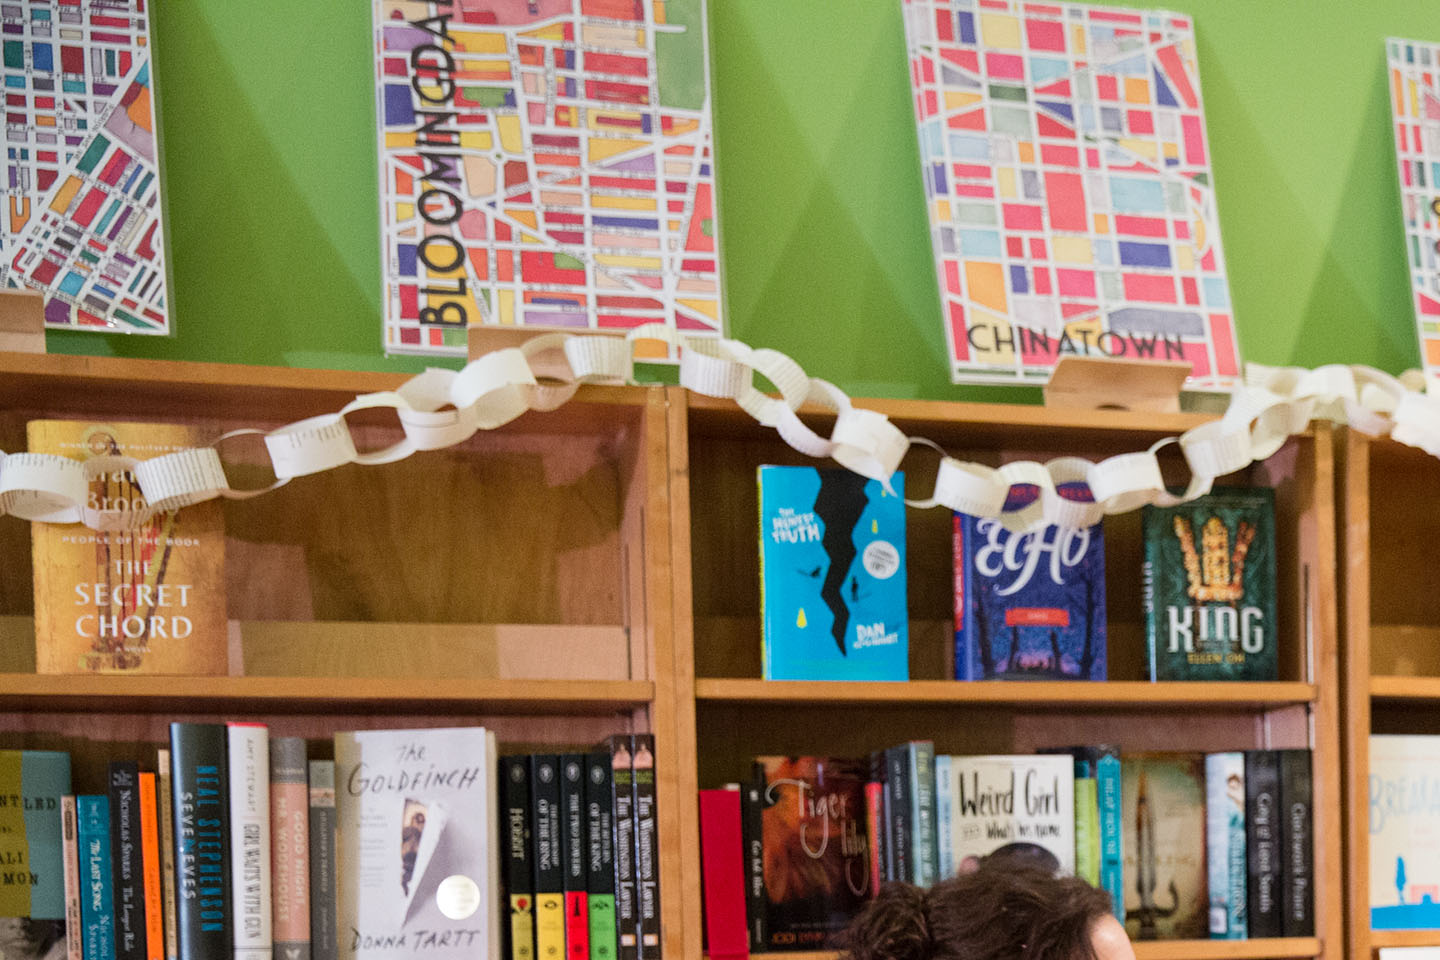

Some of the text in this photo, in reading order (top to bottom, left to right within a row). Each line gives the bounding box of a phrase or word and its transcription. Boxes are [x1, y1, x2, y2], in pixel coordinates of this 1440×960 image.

[967, 322, 1184, 362] CHINATOWN
[114, 559, 153, 576] THE
[74, 583, 193, 608] SECRET
[74, 615, 193, 639] CHORD
[399, 742, 426, 762] The
[959, 767, 1061, 818] Weird Girl
[765, 778, 850, 860] Tiger
[181, 792, 196, 899] SEVENEVES
[196, 765, 225, 932] NEAL STEPHENSON
[350, 927, 481, 952] DONNA TARTT
